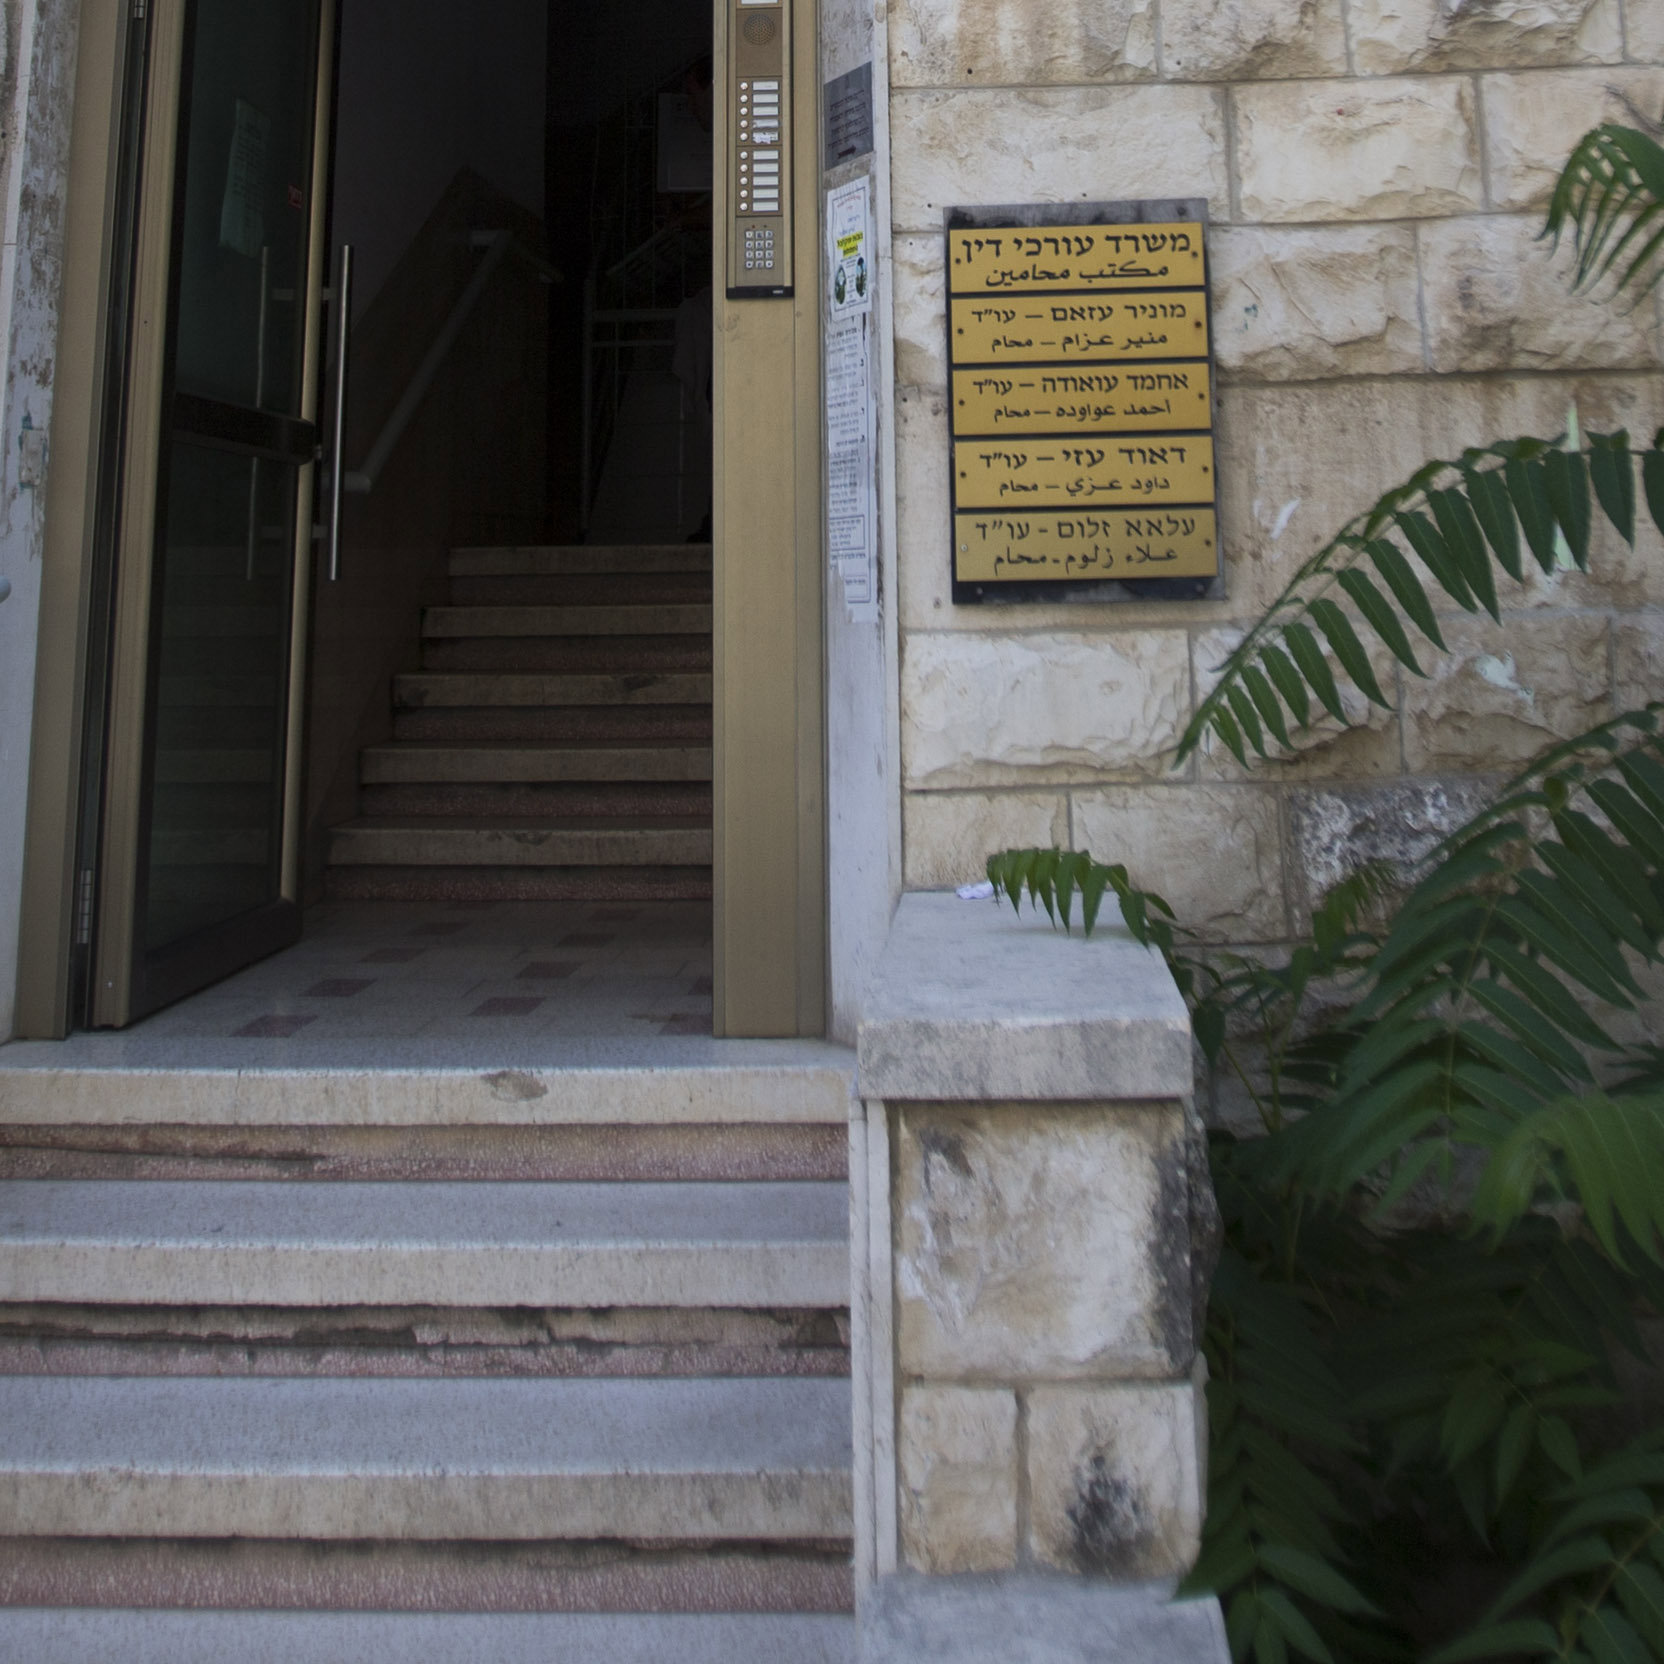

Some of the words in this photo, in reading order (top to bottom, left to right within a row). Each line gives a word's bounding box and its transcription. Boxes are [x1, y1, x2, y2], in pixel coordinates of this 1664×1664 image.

[961, 237, 1003, 264] דין
[1013, 234, 1095, 257] עורכי
[1105, 232, 1191, 254] משרד
[985, 263, 1071, 287] محامين
[1078, 260, 1169, 284] مكتب
[1050, 304, 1114, 323] עזאם
[1124, 302, 1187, 321] מוניר
[991, 335, 1034, 353] محام
[1119, 331, 1168, 351] منير
[1041, 375, 1119, 394] עואודה
[1125, 372, 1189, 391] אחמד
[993, 405, 1031, 423] محام
[1062, 448, 1106, 469] עזי
[1118, 446, 1187, 465] דאוד
[999, 480, 1039, 496] محام
[1130, 476, 1171, 495] داود
[1057, 516, 1111, 539] זלום
[1125, 515, 1197, 538] עלאא
